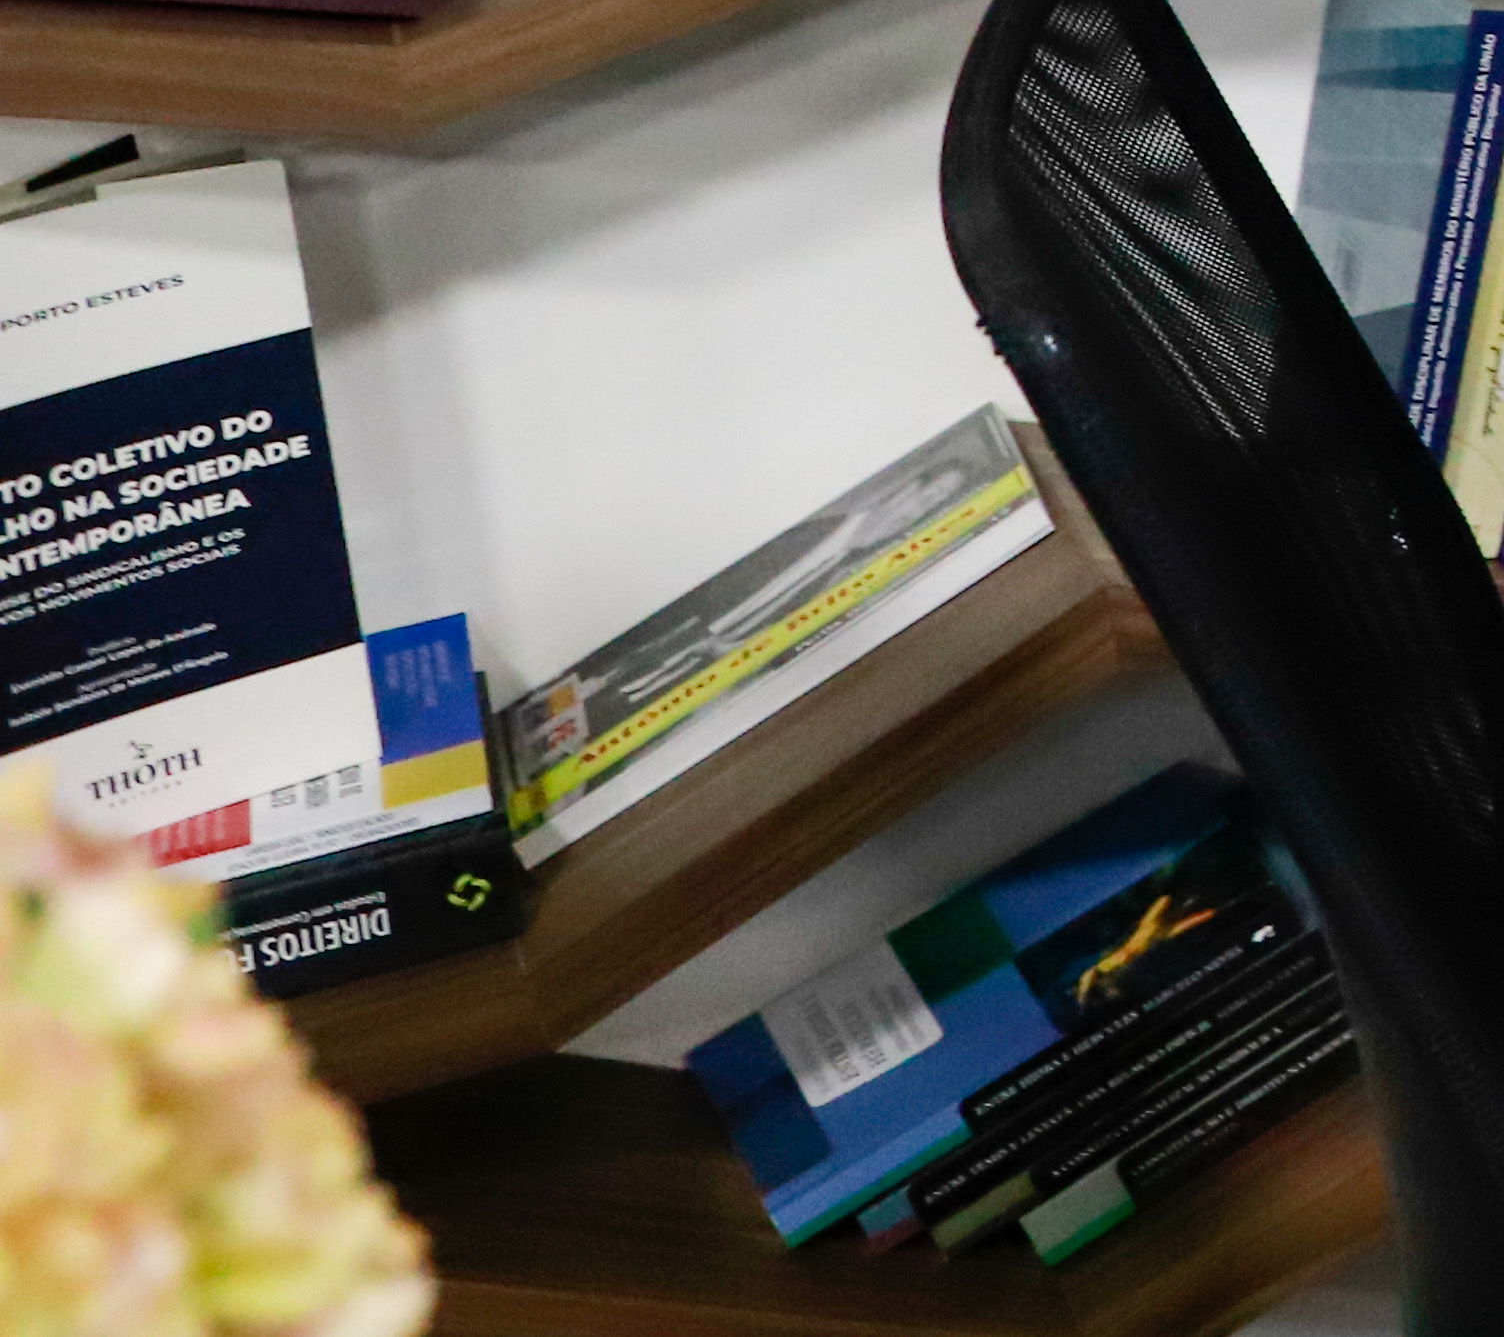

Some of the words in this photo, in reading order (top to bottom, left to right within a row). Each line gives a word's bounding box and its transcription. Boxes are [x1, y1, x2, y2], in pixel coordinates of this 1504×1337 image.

[1477, 33, 1497, 73] UNIÃO
[1474, 74, 1489, 92] DA
[1463, 93, 1485, 146] PÚBLICO
[1449, 147, 1475, 218] MINISTÉRIO
[1445, 219, 1460, 239] DO
[85, 274, 184, 309] ESTEVES
[1432, 240, 1456, 303] MEMBROS
[1428, 305, 1443, 323] DE
[1413, 324, 1439, 401] DISCIPLINAR
[48, 425, 216, 488] COLETIVO
[220, 409, 274, 441] DO
[61, 492, 116, 523] NA
[118, 434, 312, 505] SOCIEDADE
[90, 748, 201, 801] THOTH
[260, 907, 393, 968] DIREITOS
